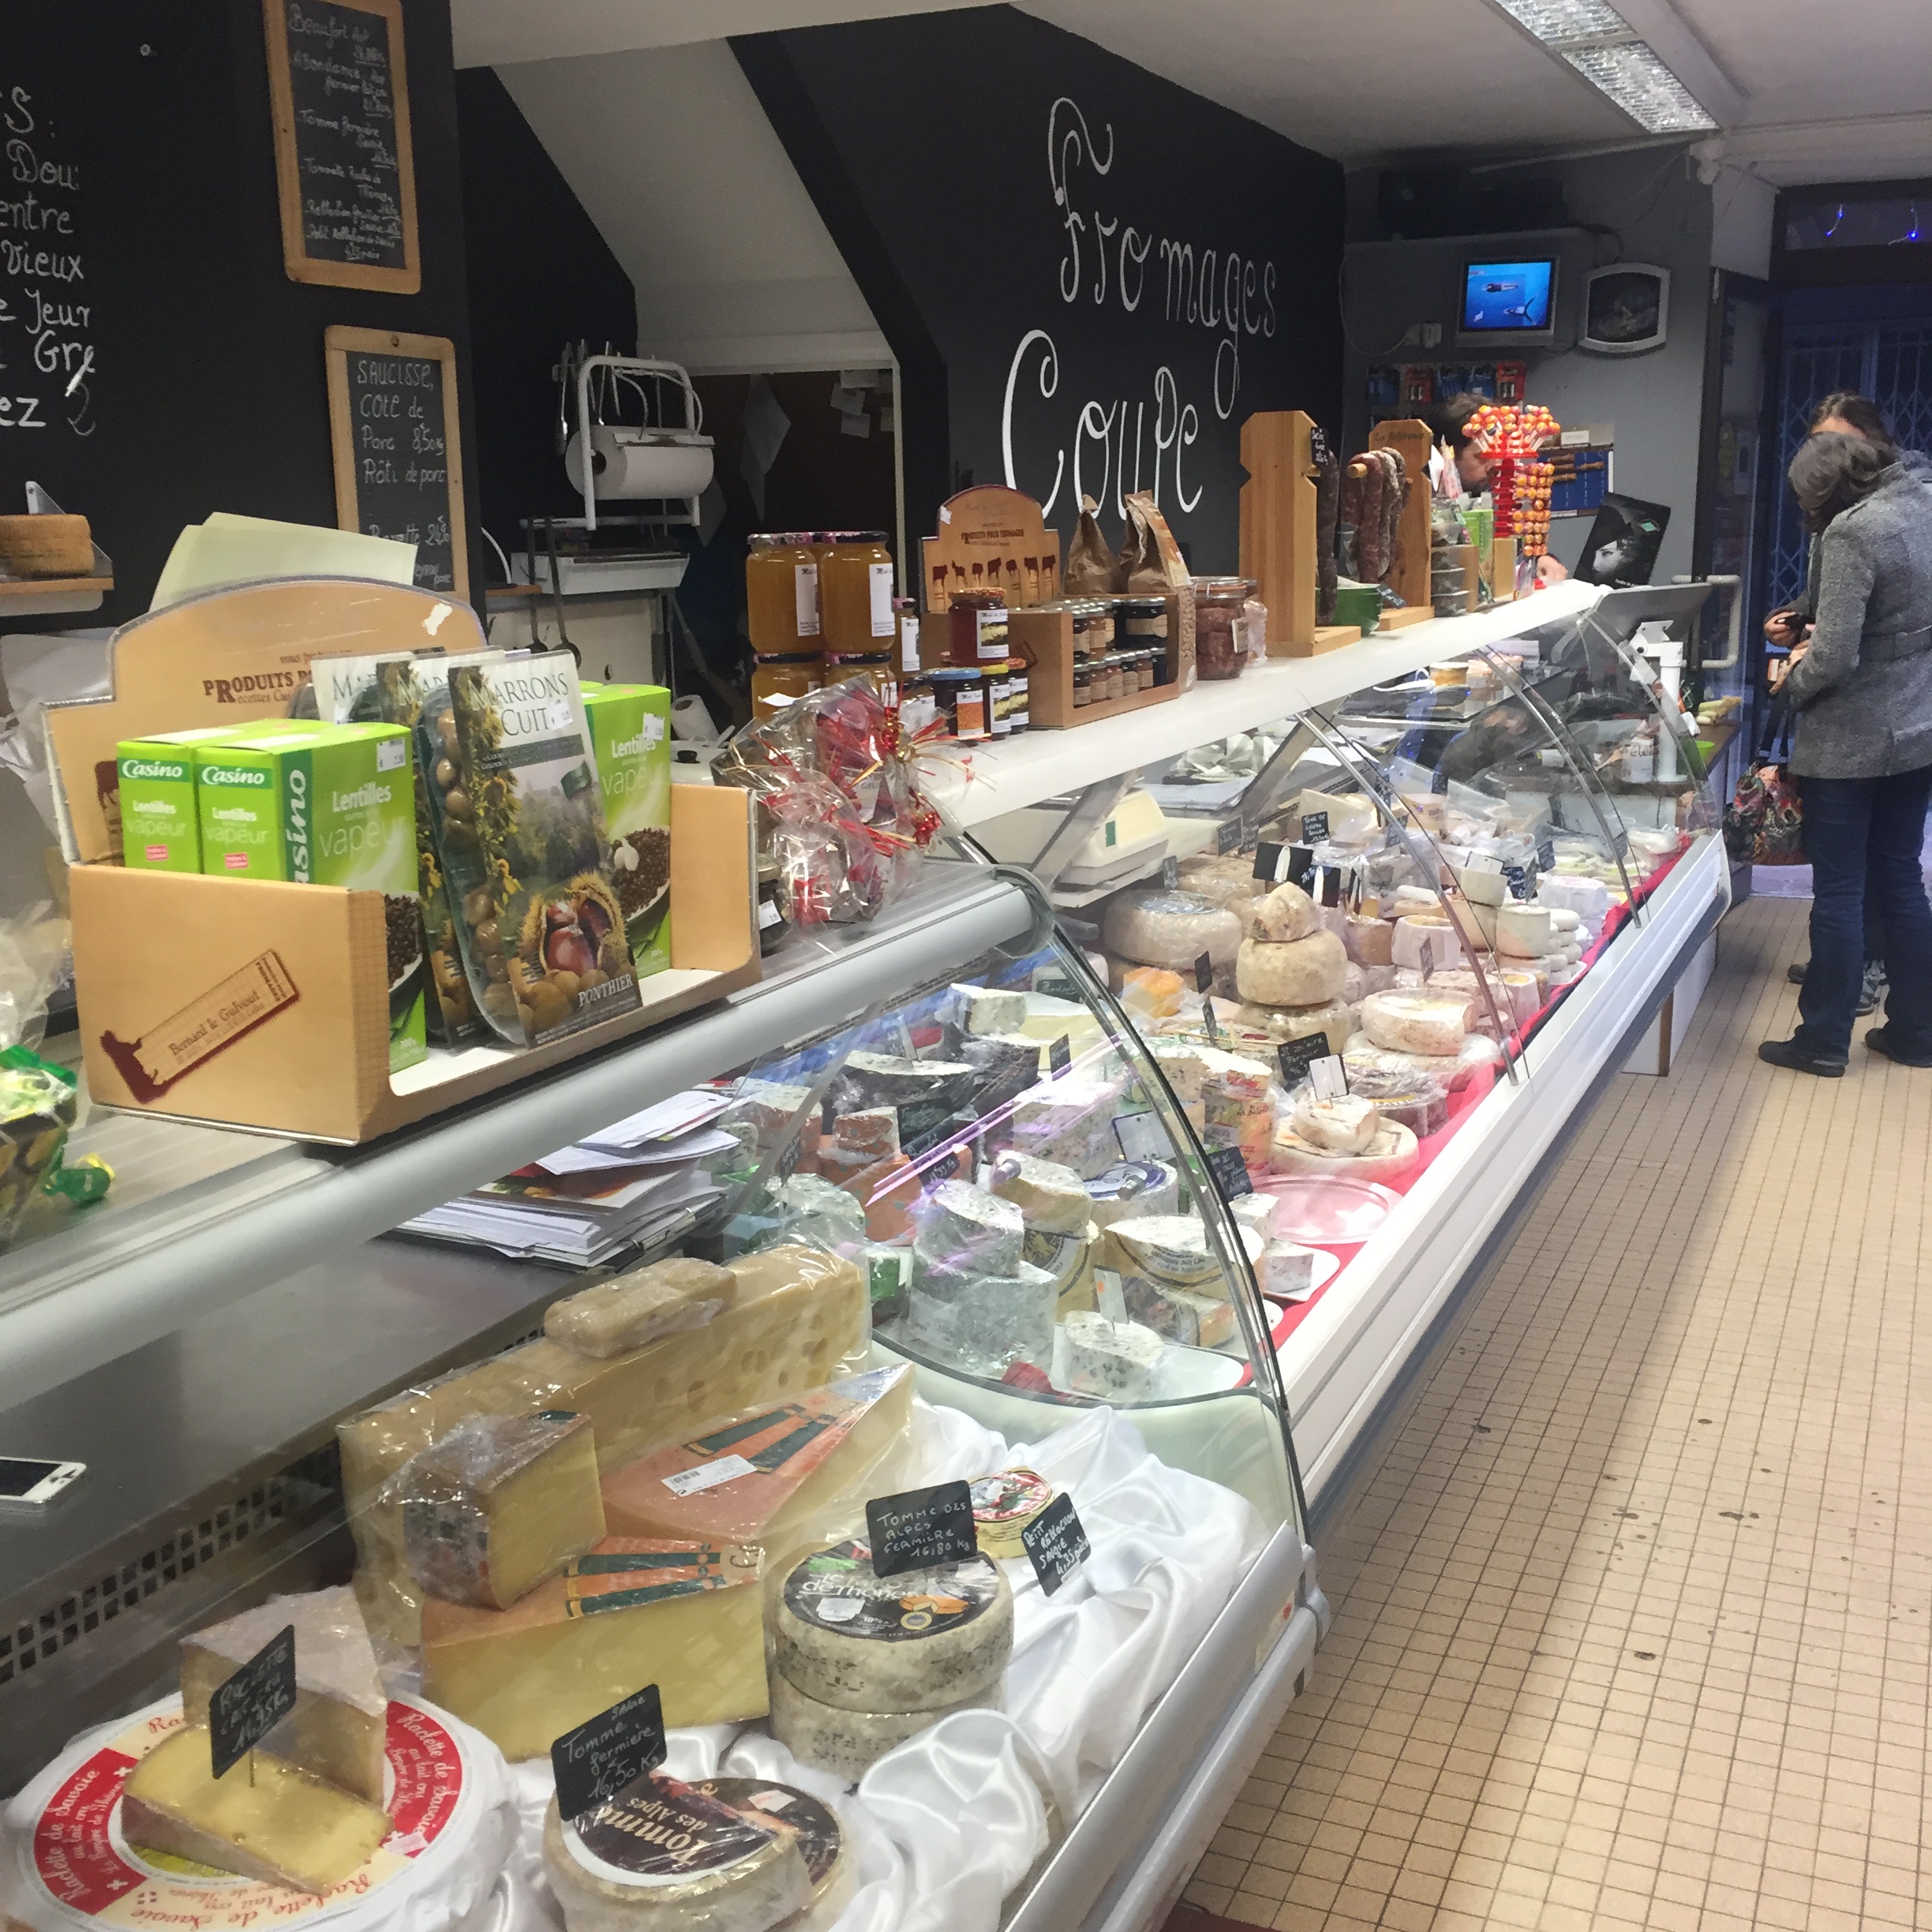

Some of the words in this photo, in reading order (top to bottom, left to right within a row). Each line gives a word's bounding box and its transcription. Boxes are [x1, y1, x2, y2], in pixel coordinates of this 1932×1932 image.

[1048, 96, 1276, 420] Fromages
[203, 671, 294, 703] PRODUITS
[469, 672, 569, 711] MARRONS
[500, 702, 556, 736] CUIT
[612, 732, 657, 758] Lentilles
[122, 760, 183, 778] Casino
[201, 766, 265, 785] Casino
[332, 781, 392, 813] Lentilles
[125, 818, 186, 838] vapeur
[204, 826, 268, 846] vapeur
[285, 769, 310, 883] asino
[578, 972, 635, 1008] PONTHIER
[876, 1507, 937, 1528] TOMME
[943, 1502, 967, 1514] DES
[885, 1522, 932, 1541] ALPES
[562, 1721, 628, 1763] Tomme
[434, 1762, 456, 1779] de
[45, 1769, 100, 1818] Savoie
[626, 1794, 672, 1826] Alpes
[675, 1810, 710, 1833] des
[41, 1822, 65, 1840] de
[597, 1803, 712, 1866] Tomme
